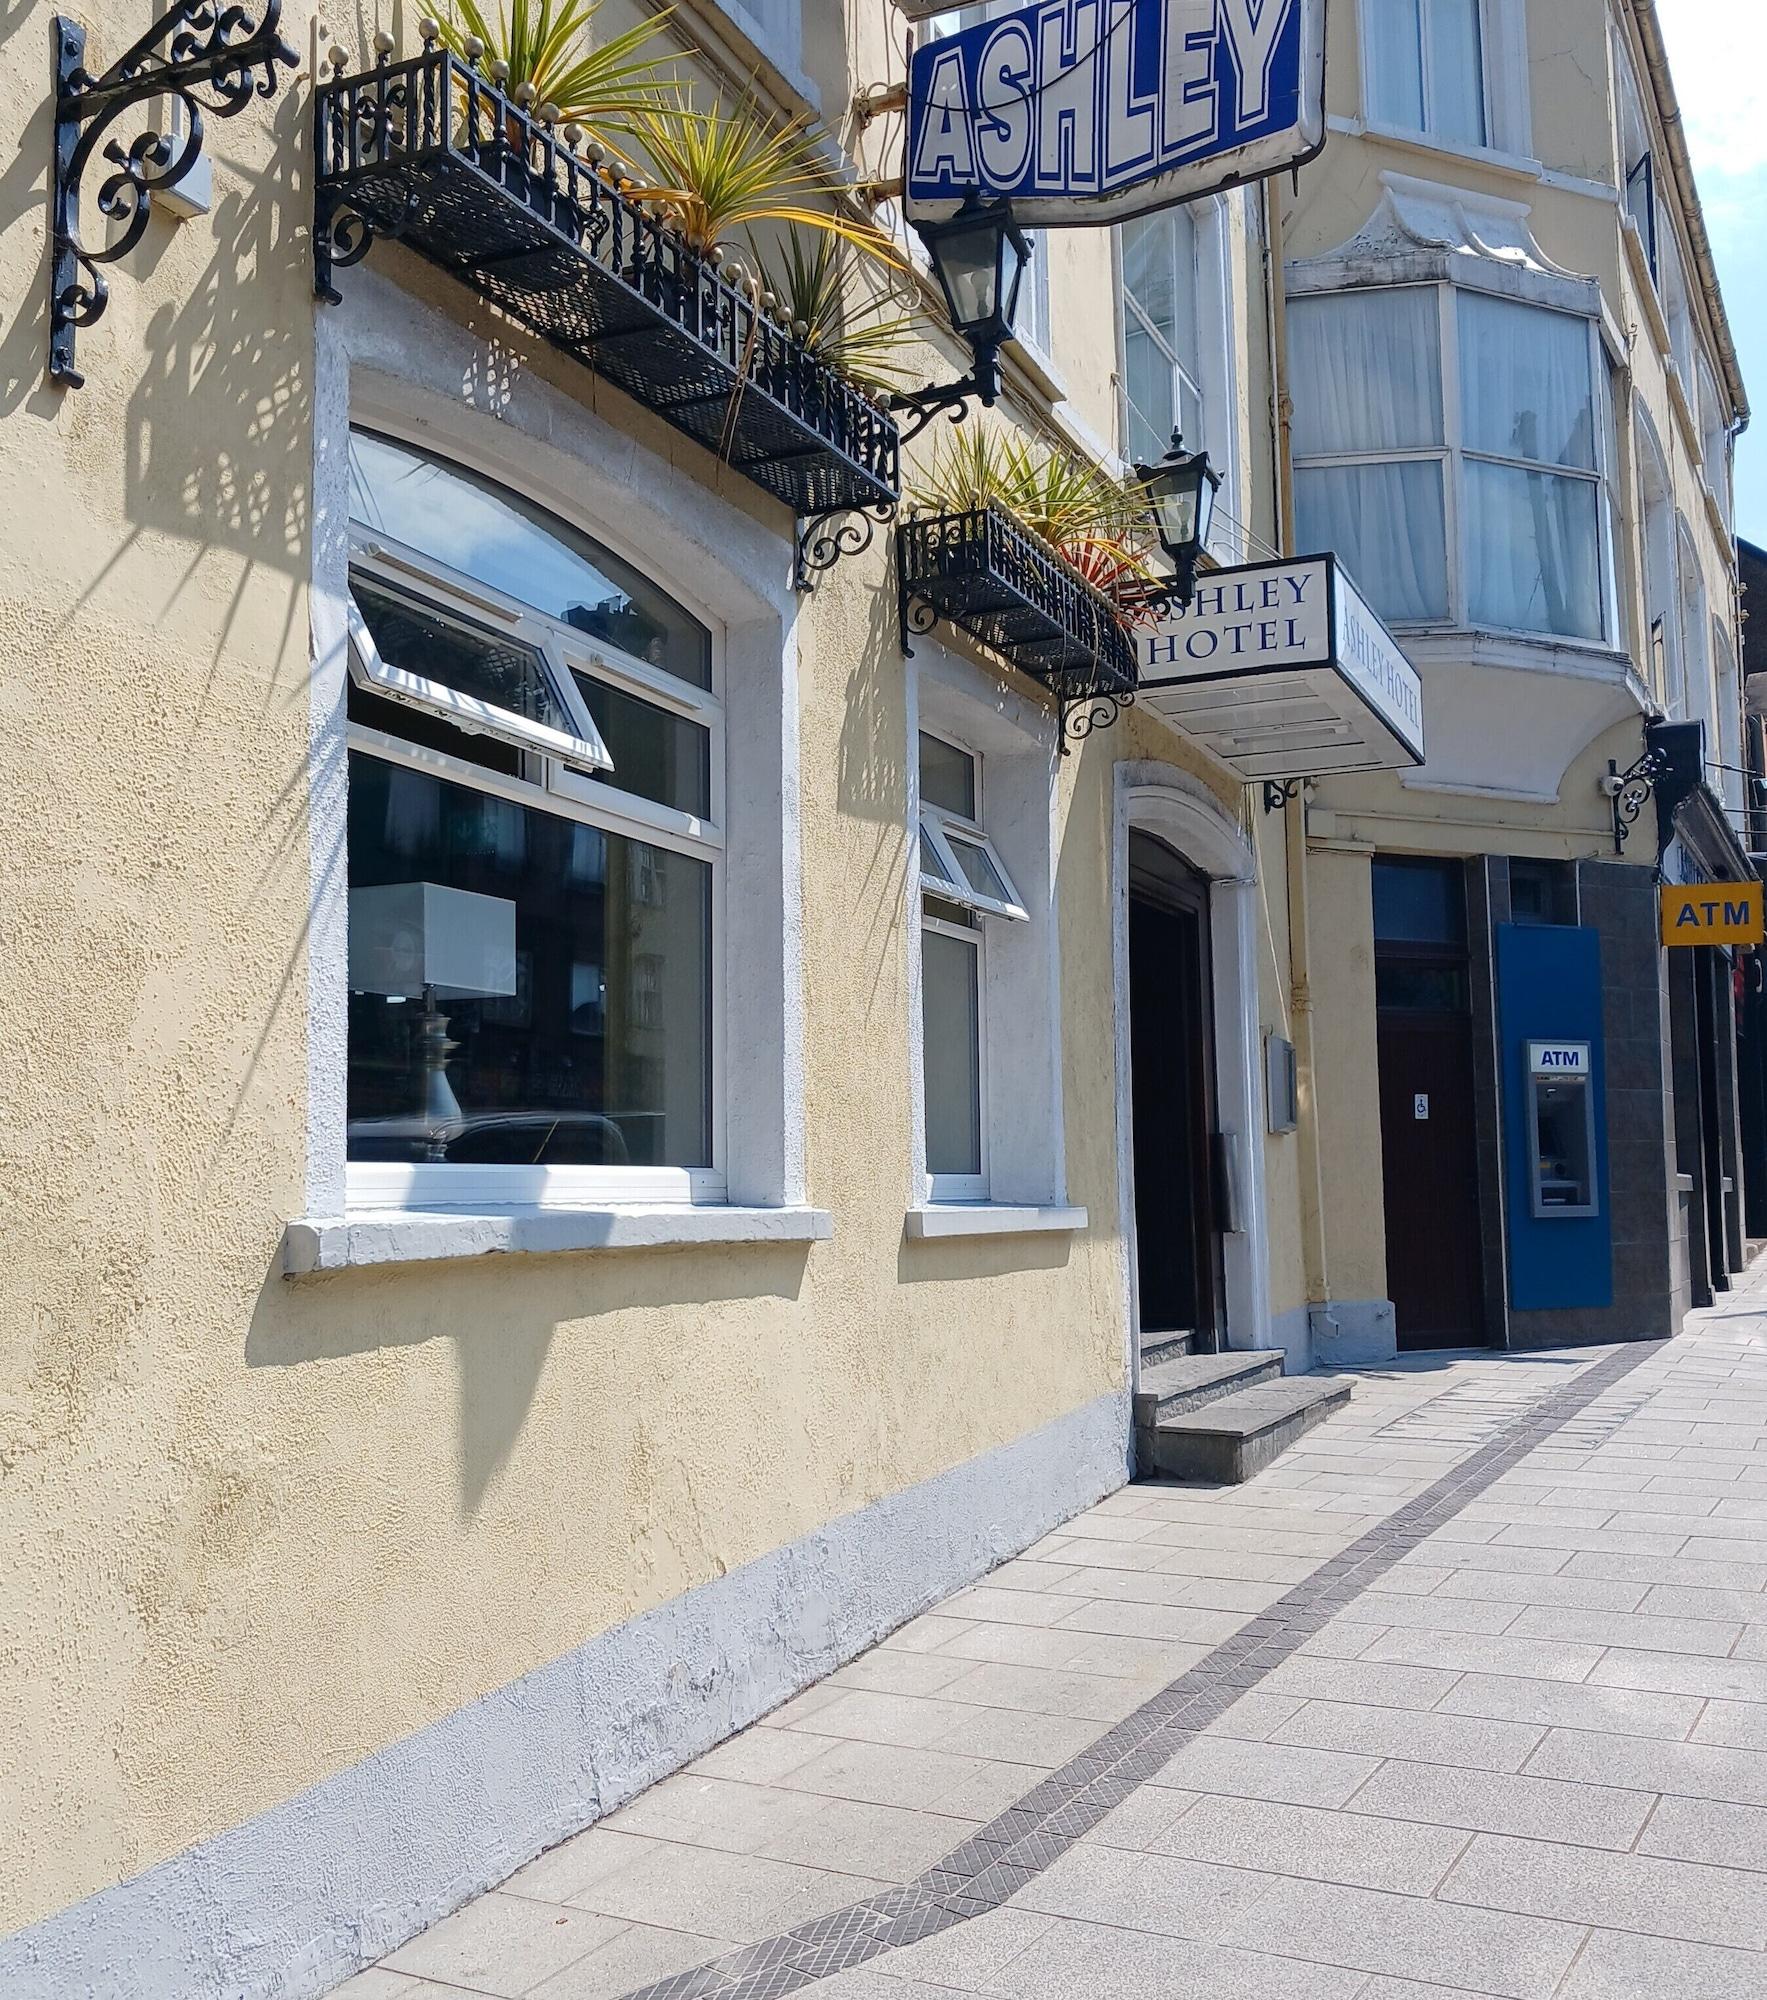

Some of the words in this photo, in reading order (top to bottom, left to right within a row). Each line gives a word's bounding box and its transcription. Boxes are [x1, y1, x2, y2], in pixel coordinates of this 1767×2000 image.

[911, 0, 1292, 192] ASHLEY
[1152, 574, 1312, 624] SHLEY
[1146, 618, 1306, 666] HOTEL
[1343, 606, 1384, 687] ASHLEY
[1385, 659, 1420, 729] HOTEL
[1676, 901, 1749, 927] ATM
[1541, 1051, 1579, 1066] ATM
